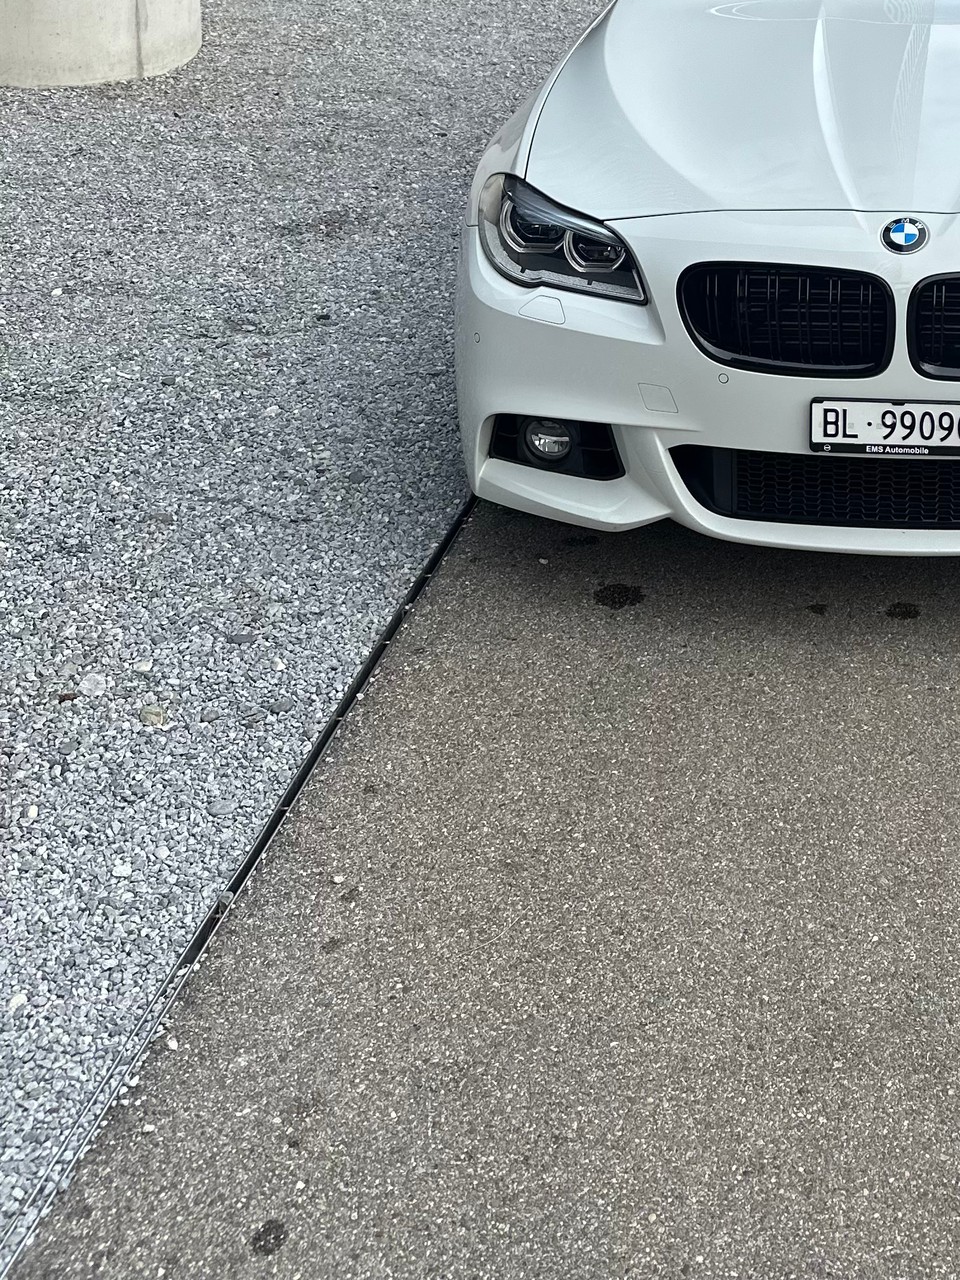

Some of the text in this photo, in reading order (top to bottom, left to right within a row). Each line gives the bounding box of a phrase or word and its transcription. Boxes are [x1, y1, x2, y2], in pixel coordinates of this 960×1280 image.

[887, 218, 924, 229] BMW
[866, 445, 929, 455] EMS Automobile
